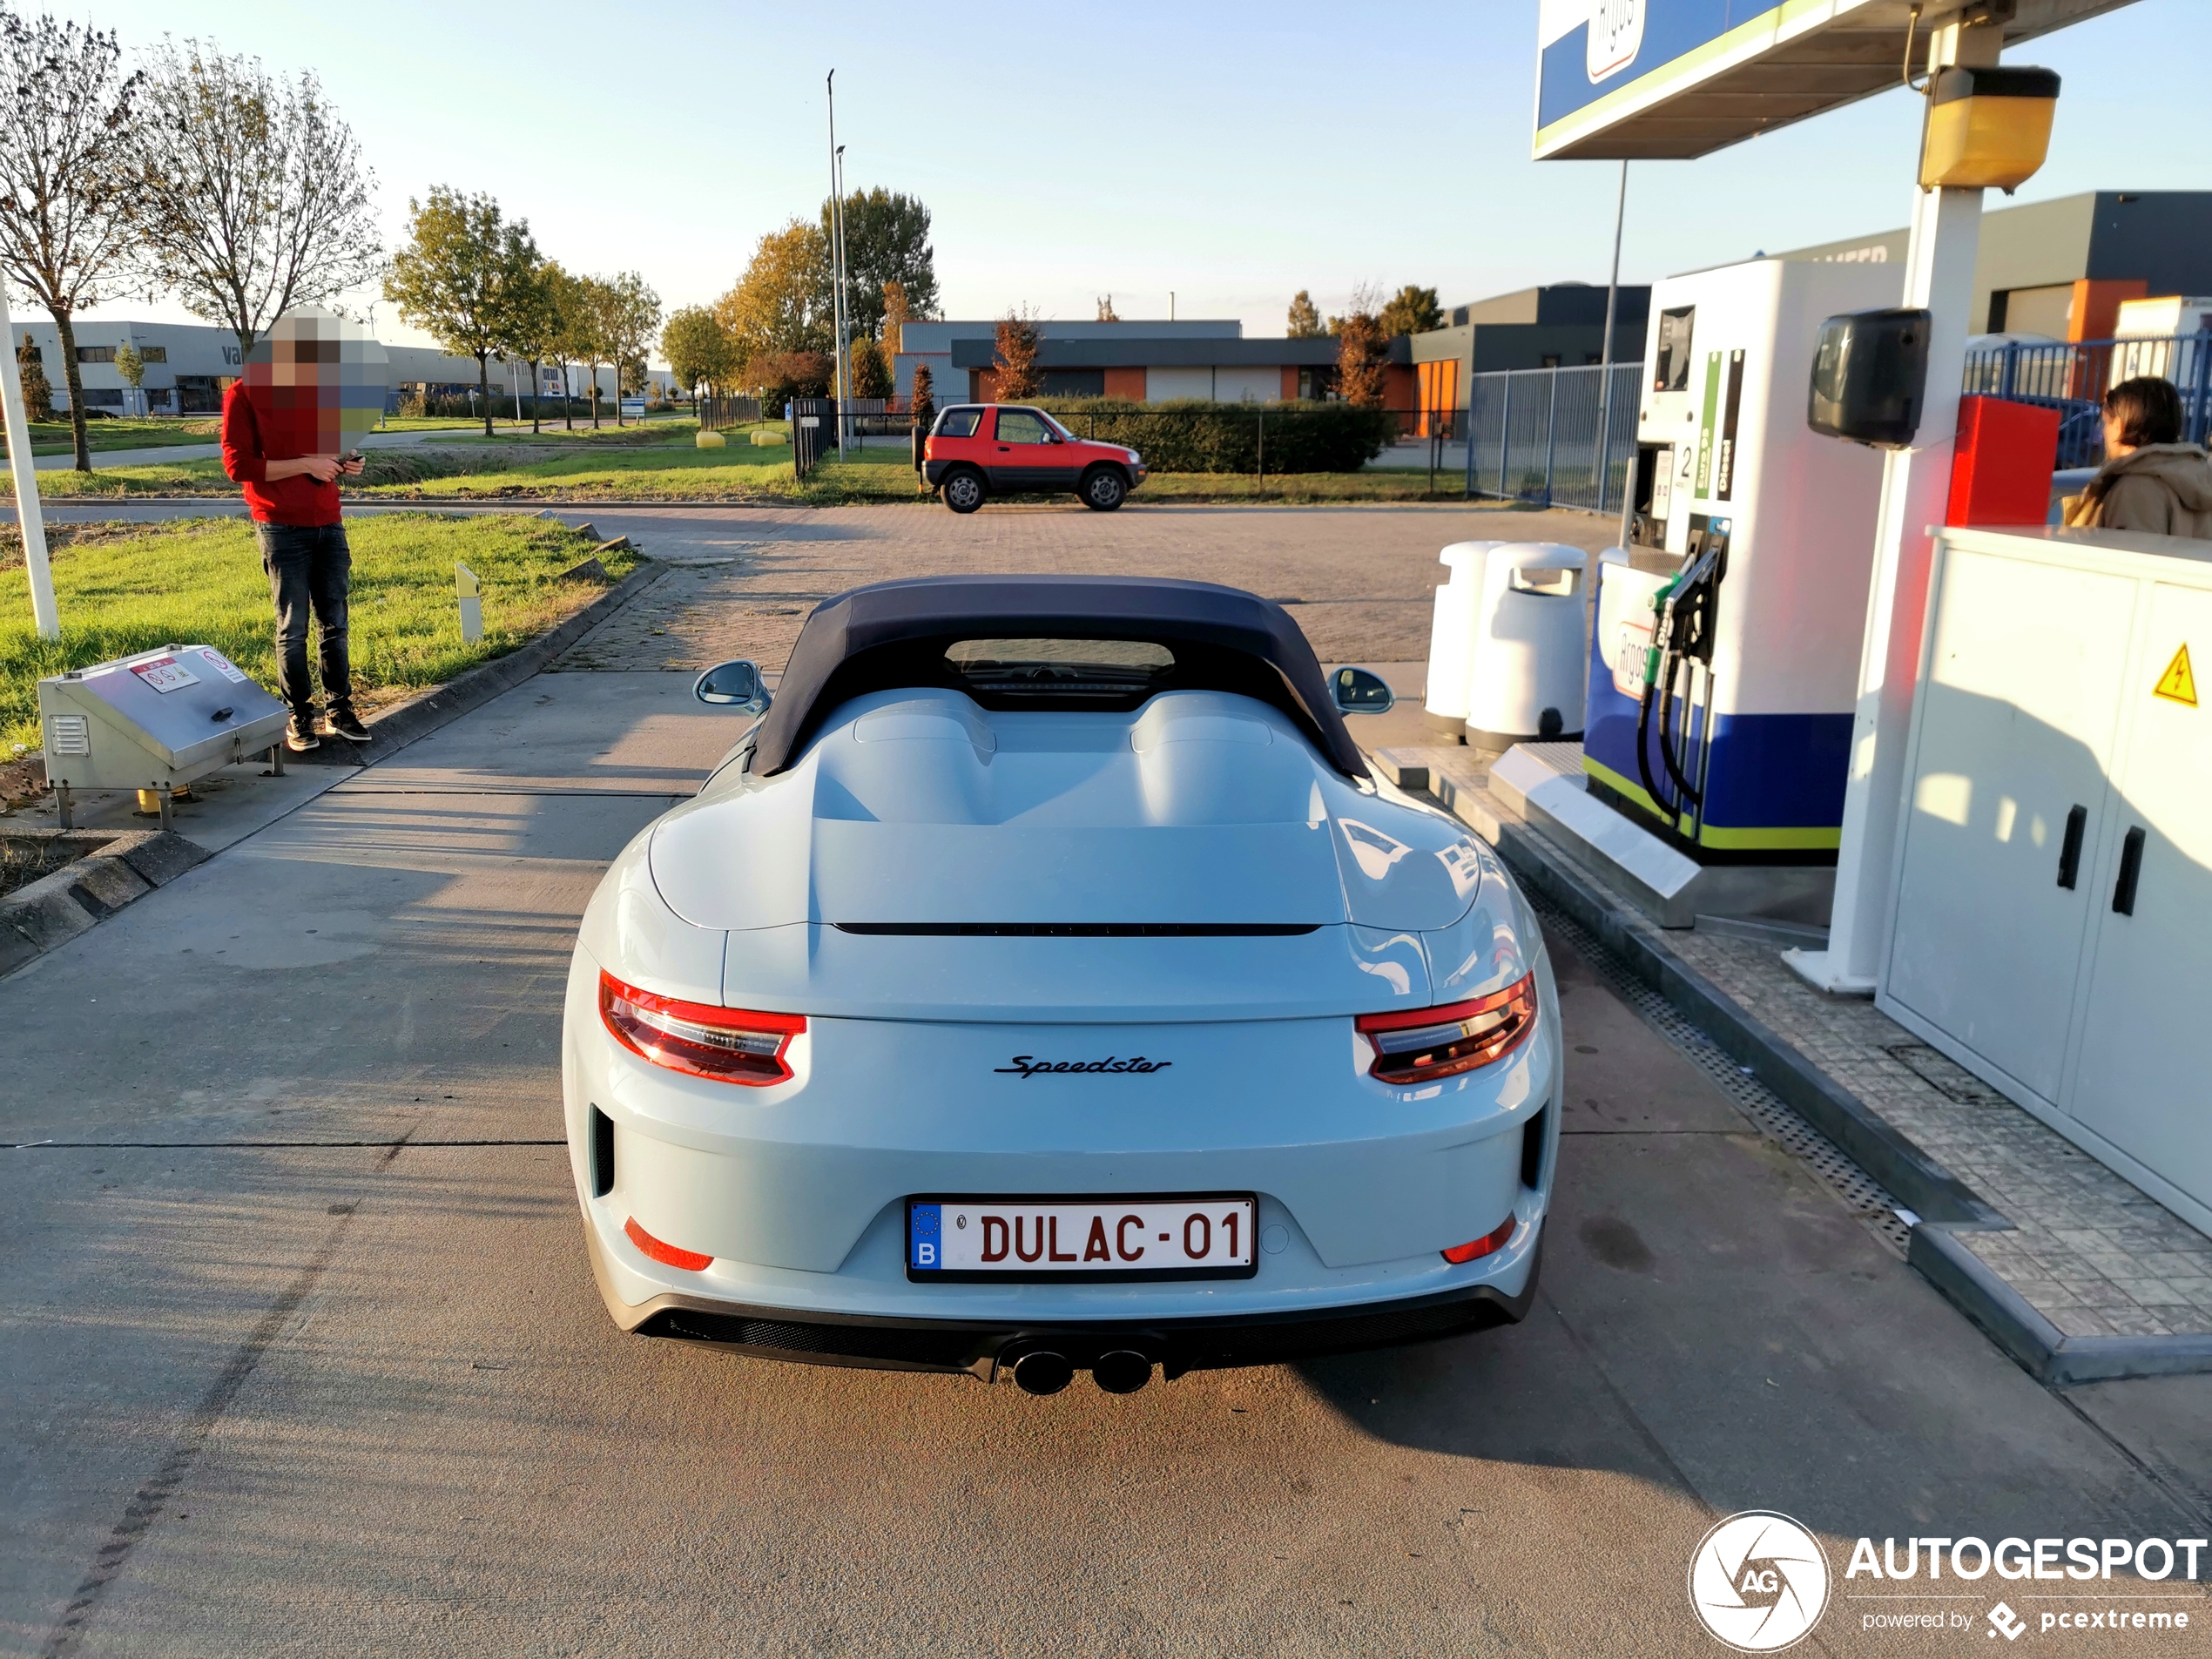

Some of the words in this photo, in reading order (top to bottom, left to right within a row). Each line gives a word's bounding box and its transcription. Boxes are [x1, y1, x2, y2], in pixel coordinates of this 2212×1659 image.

[221, 346, 244, 366] va
[1681, 445, 1692, 478] 2
[1696, 450, 1708, 489] Euro
[1718, 439, 1731, 492] Diesel
[1619, 632, 1648, 685] Argos
[994, 1055, 1173, 1079] Speedster
[918, 1243, 936, 1264] B
[981, 1211, 1239, 1263] DULAC-01
